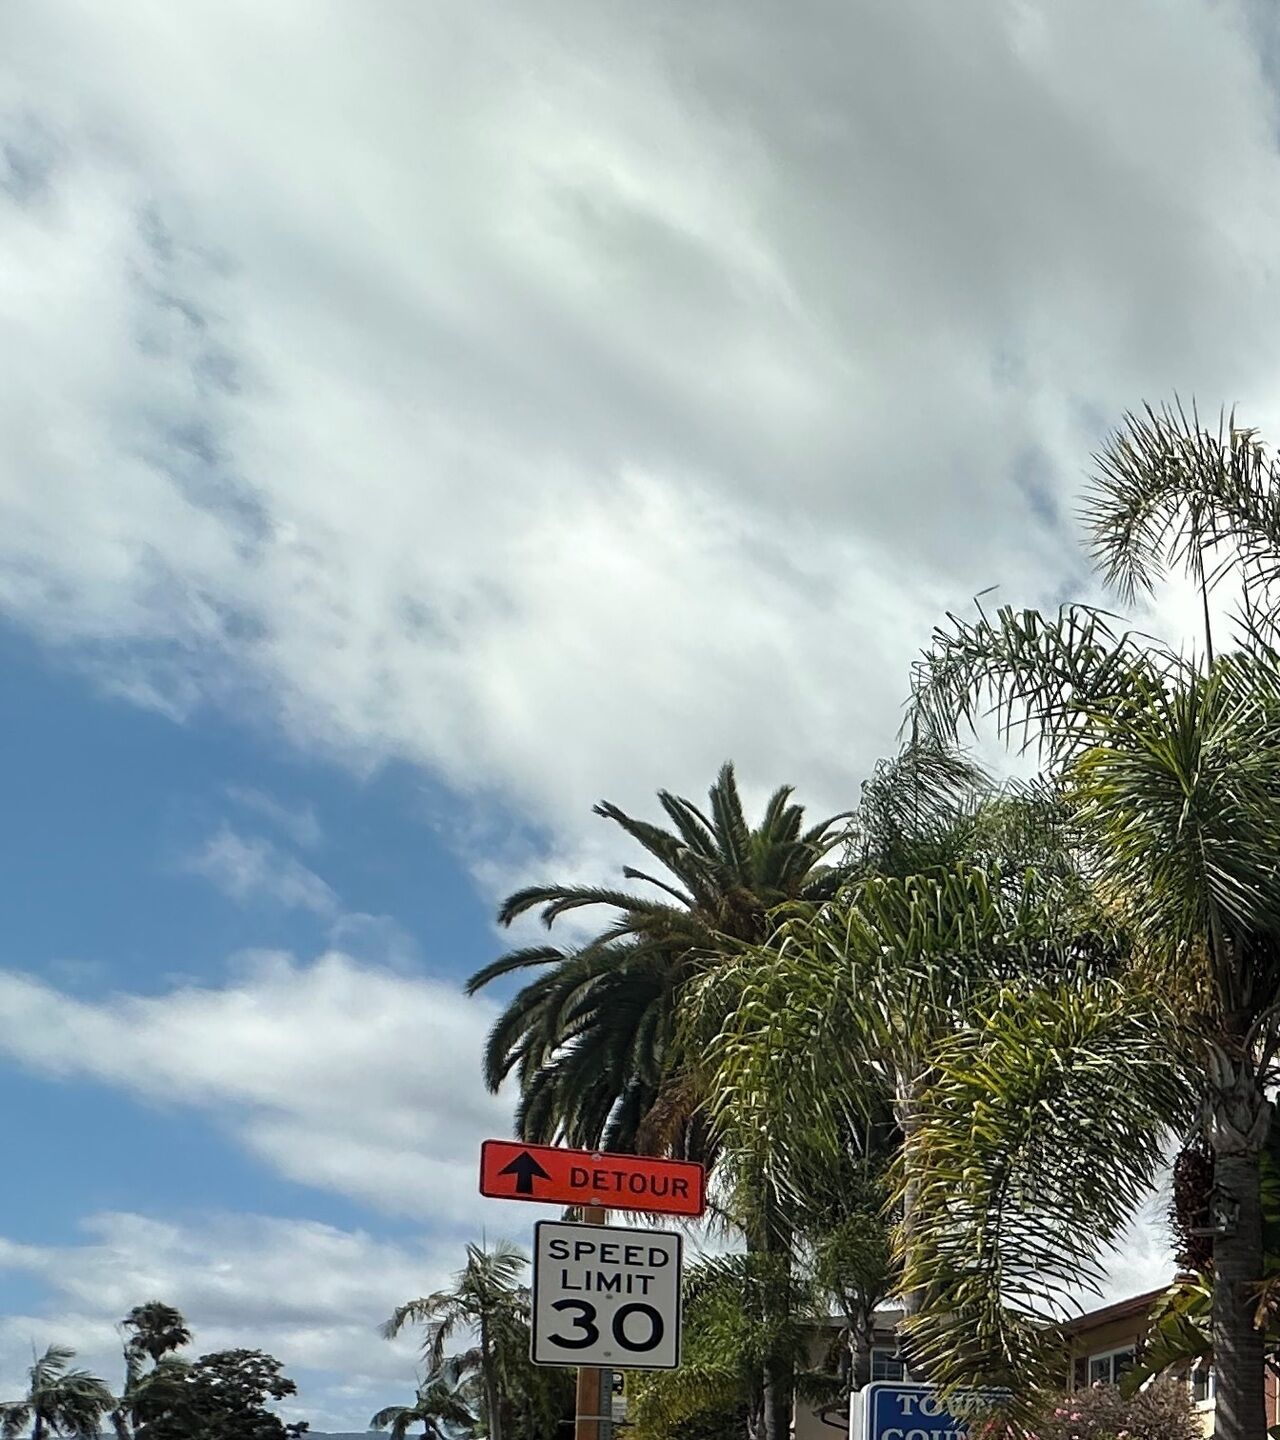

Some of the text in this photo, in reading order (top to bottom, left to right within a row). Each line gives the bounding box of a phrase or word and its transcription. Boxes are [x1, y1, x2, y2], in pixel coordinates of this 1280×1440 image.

[570, 1168, 689, 1198] DETOUR
[548, 1239, 669, 1268] SPEED
[561, 1269, 655, 1295] LIMIT
[547, 1298, 664, 1353] 30
